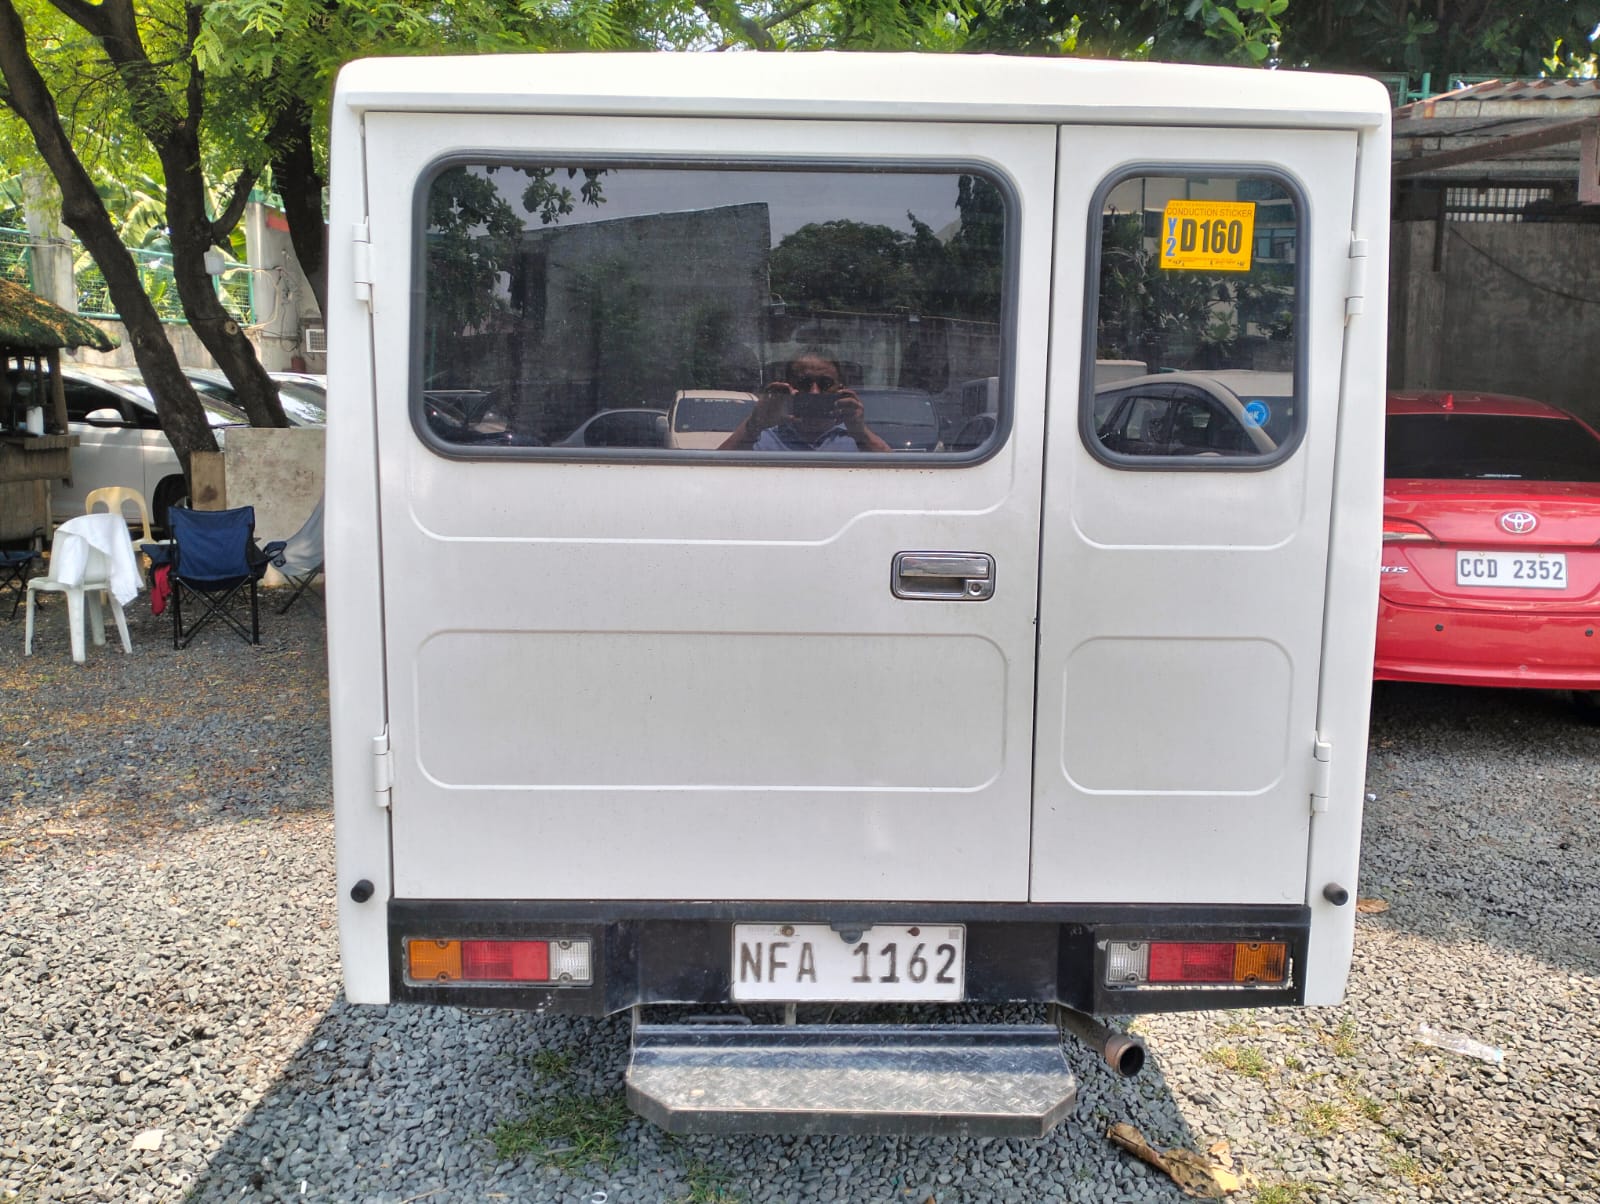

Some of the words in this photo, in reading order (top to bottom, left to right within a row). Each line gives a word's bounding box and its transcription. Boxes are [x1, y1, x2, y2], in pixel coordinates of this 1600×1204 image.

[1166, 208, 1217, 217] CONDUCTION
[1219, 208, 1253, 218] STICKER
[1180, 218, 1243, 254] D160
[1460, 558, 1498, 579] CCD
[1513, 560, 1564, 581] 2352
[740, 942, 817, 983] NFA
[852, 942, 957, 984] 1162
